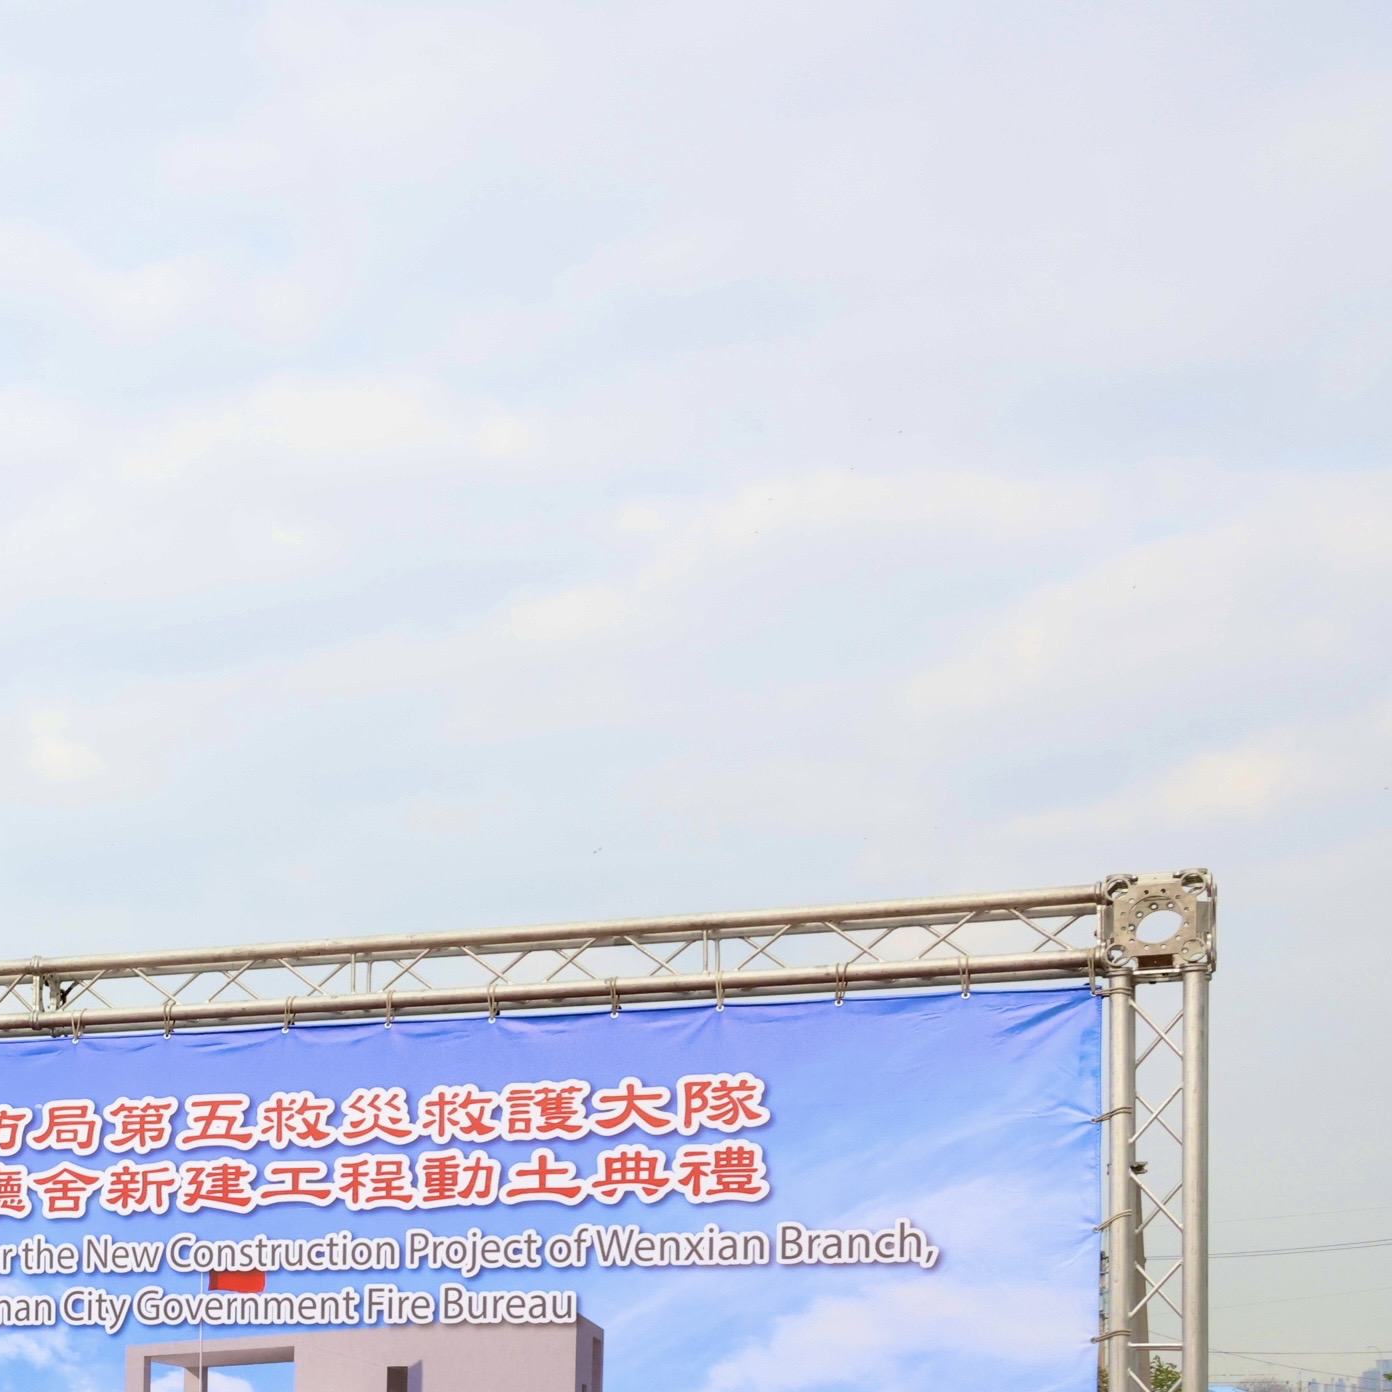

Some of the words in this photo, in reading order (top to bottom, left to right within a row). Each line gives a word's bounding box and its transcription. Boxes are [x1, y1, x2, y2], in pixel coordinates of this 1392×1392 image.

[23, 1239, 74, 1270] the
[86, 1239, 159, 1269] New
[170, 1236, 395, 1268] Construction
[411, 1231, 537, 1273] Project
[550, 1227, 589, 1263] of
[598, 1227, 764, 1262] Wenxian
[781, 1222, 939, 1267] Branch,
[64, 1290, 126, 1332] City
[136, 1289, 354, 1324] Government
[367, 1287, 432, 1319] Fire
[441, 1287, 573, 1320] Bureau
